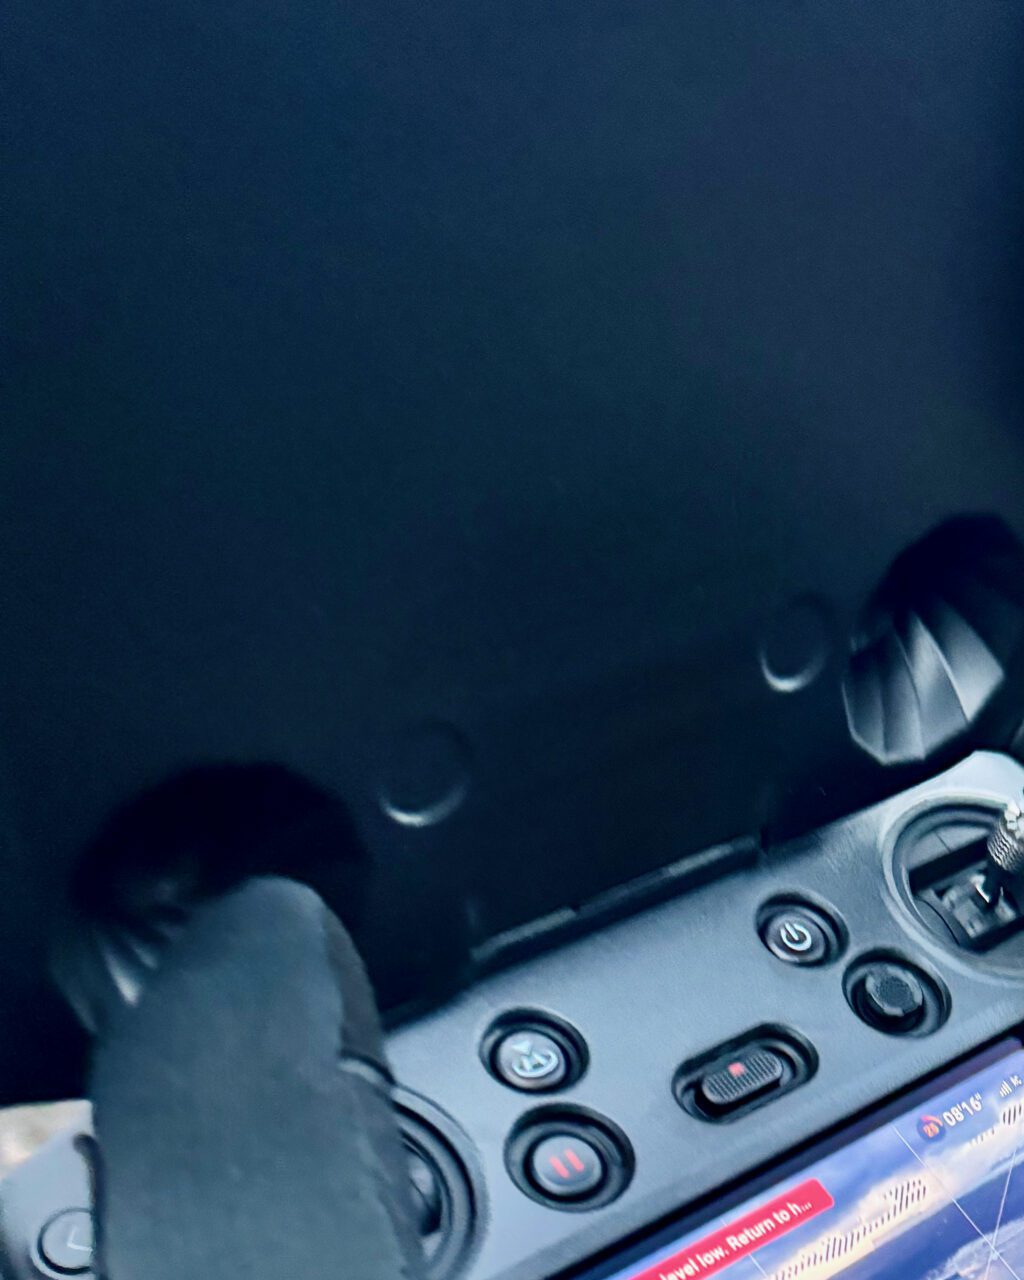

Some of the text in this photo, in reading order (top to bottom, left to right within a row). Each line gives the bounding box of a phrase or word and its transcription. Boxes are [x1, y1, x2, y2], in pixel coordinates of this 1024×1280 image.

[697, 1247, 730, 1269] low.
[726, 1219, 776, 1251] Return
[773, 1207, 791, 1225] to
